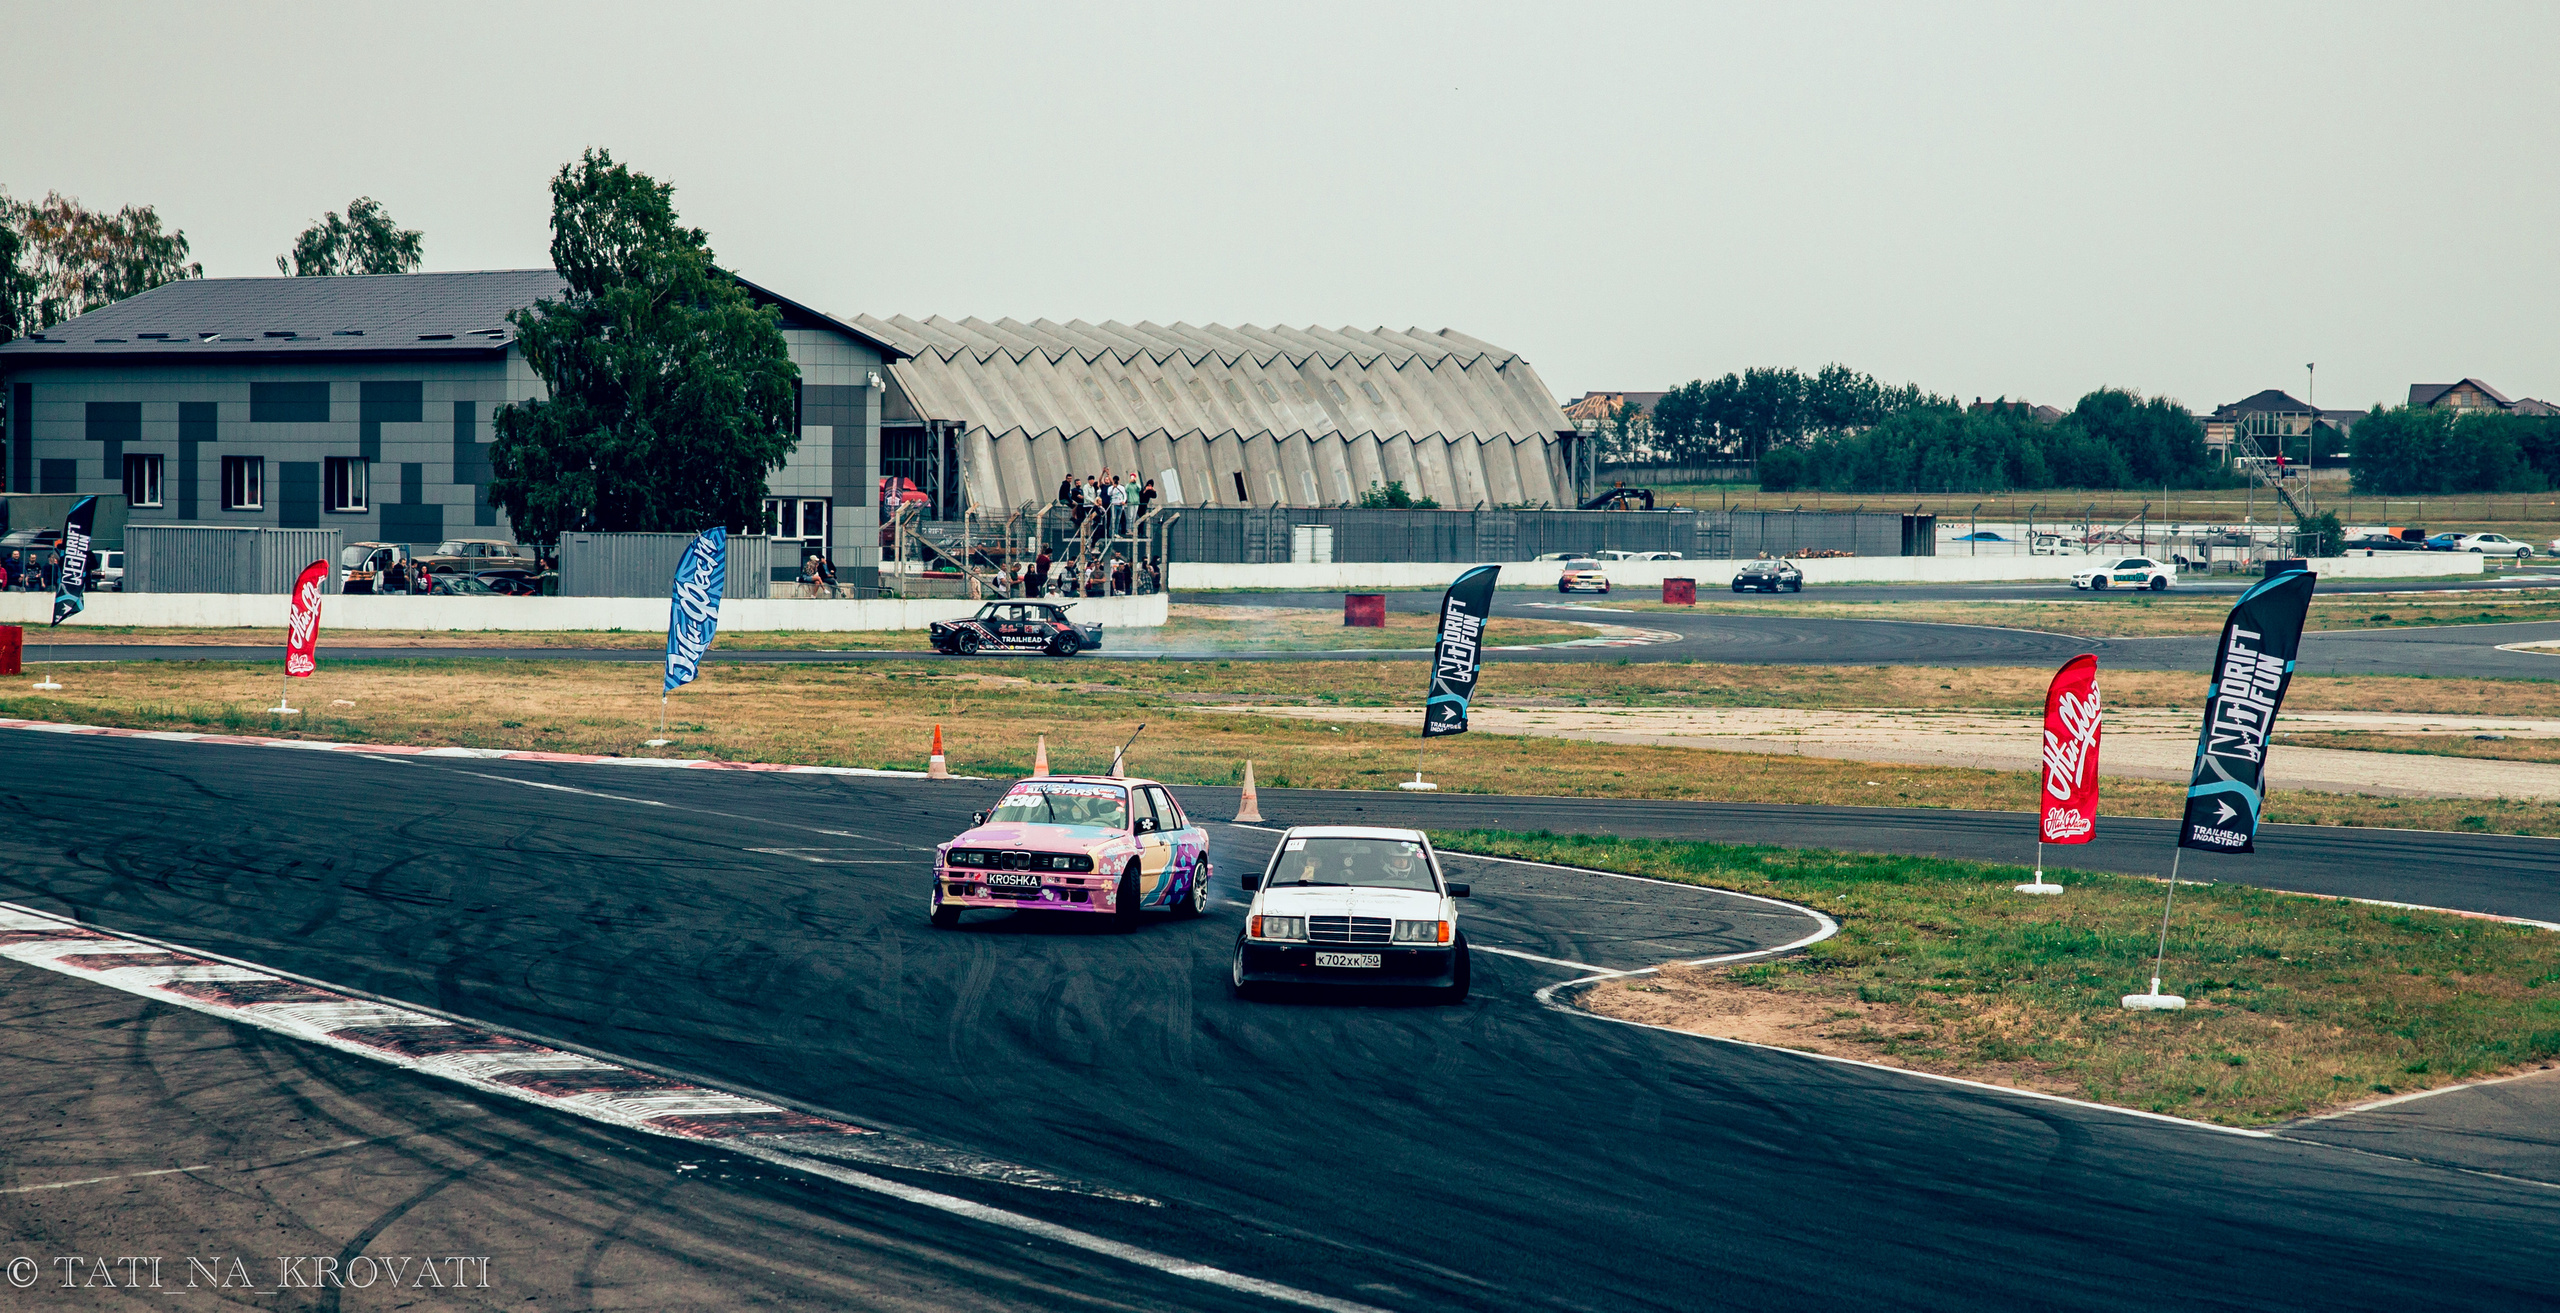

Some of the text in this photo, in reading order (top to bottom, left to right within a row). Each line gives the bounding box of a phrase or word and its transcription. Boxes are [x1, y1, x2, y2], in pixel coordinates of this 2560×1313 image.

[65, 521, 81, 555] DRIFT
[77, 534, 91, 558] FUN
[1443, 596, 1467, 643] DRIFT
[1461, 614, 1481, 646] FUN
[2220, 624, 2261, 698] DRIFT
[2250, 653, 2285, 706] FUN
[1003, 795, 1042, 808] 130
[1052, 788, 1093, 796] STARS
[2193, 825, 2248, 842] TRAILHEAD
[989, 874, 1038, 886] KROSHKA
[1362, 955, 1379, 963] 750
